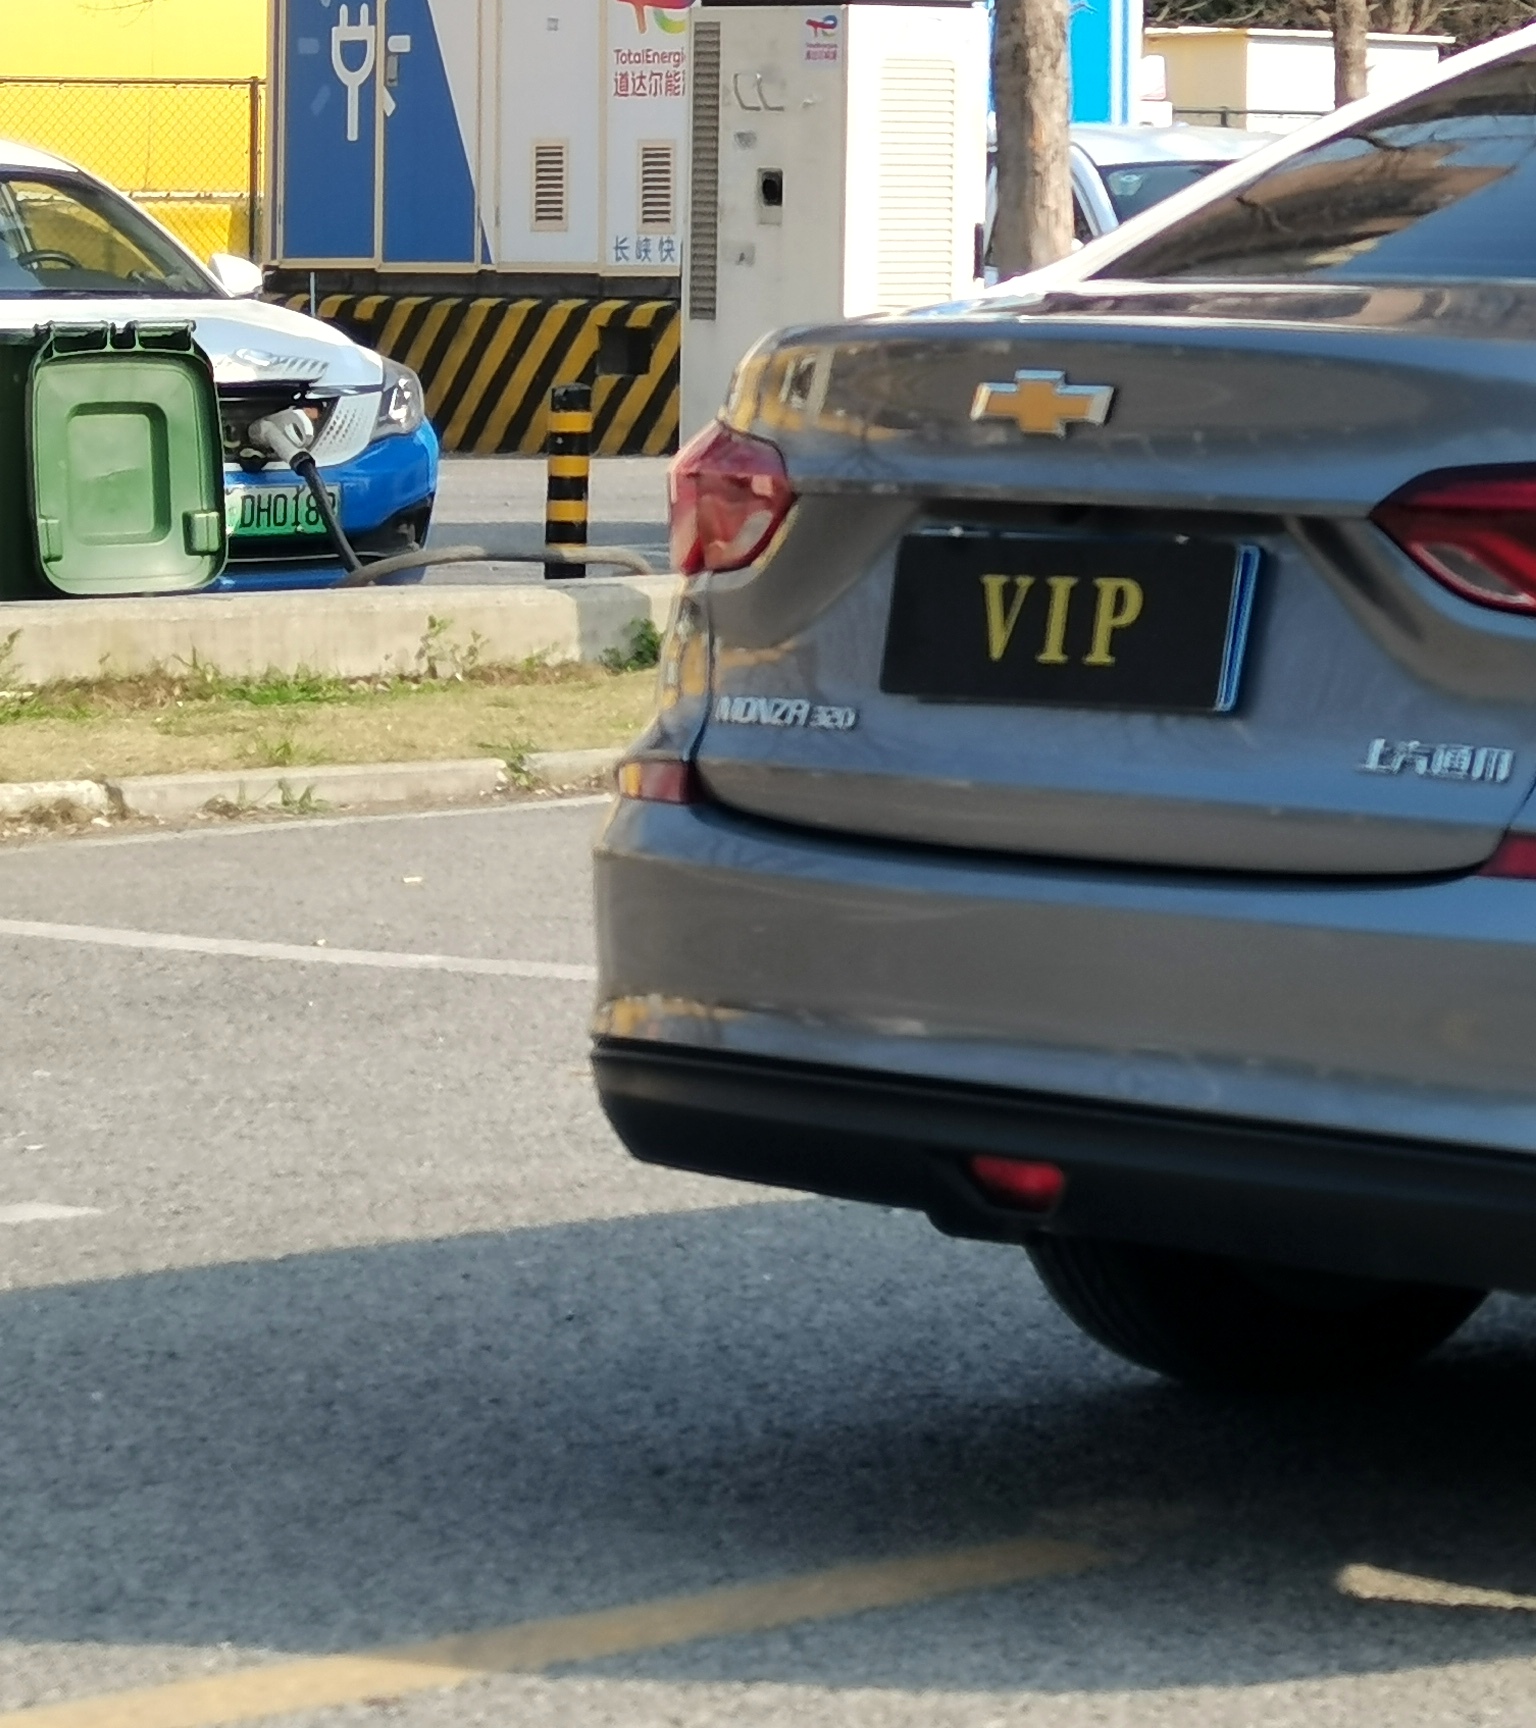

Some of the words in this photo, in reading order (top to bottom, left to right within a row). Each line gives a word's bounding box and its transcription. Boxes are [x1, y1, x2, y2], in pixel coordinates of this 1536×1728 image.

[613, 47, 687, 68] TotalEnergi
[979, 573, 1144, 666] VIP
[1354, 737, 1515, 784] 上汽通用
